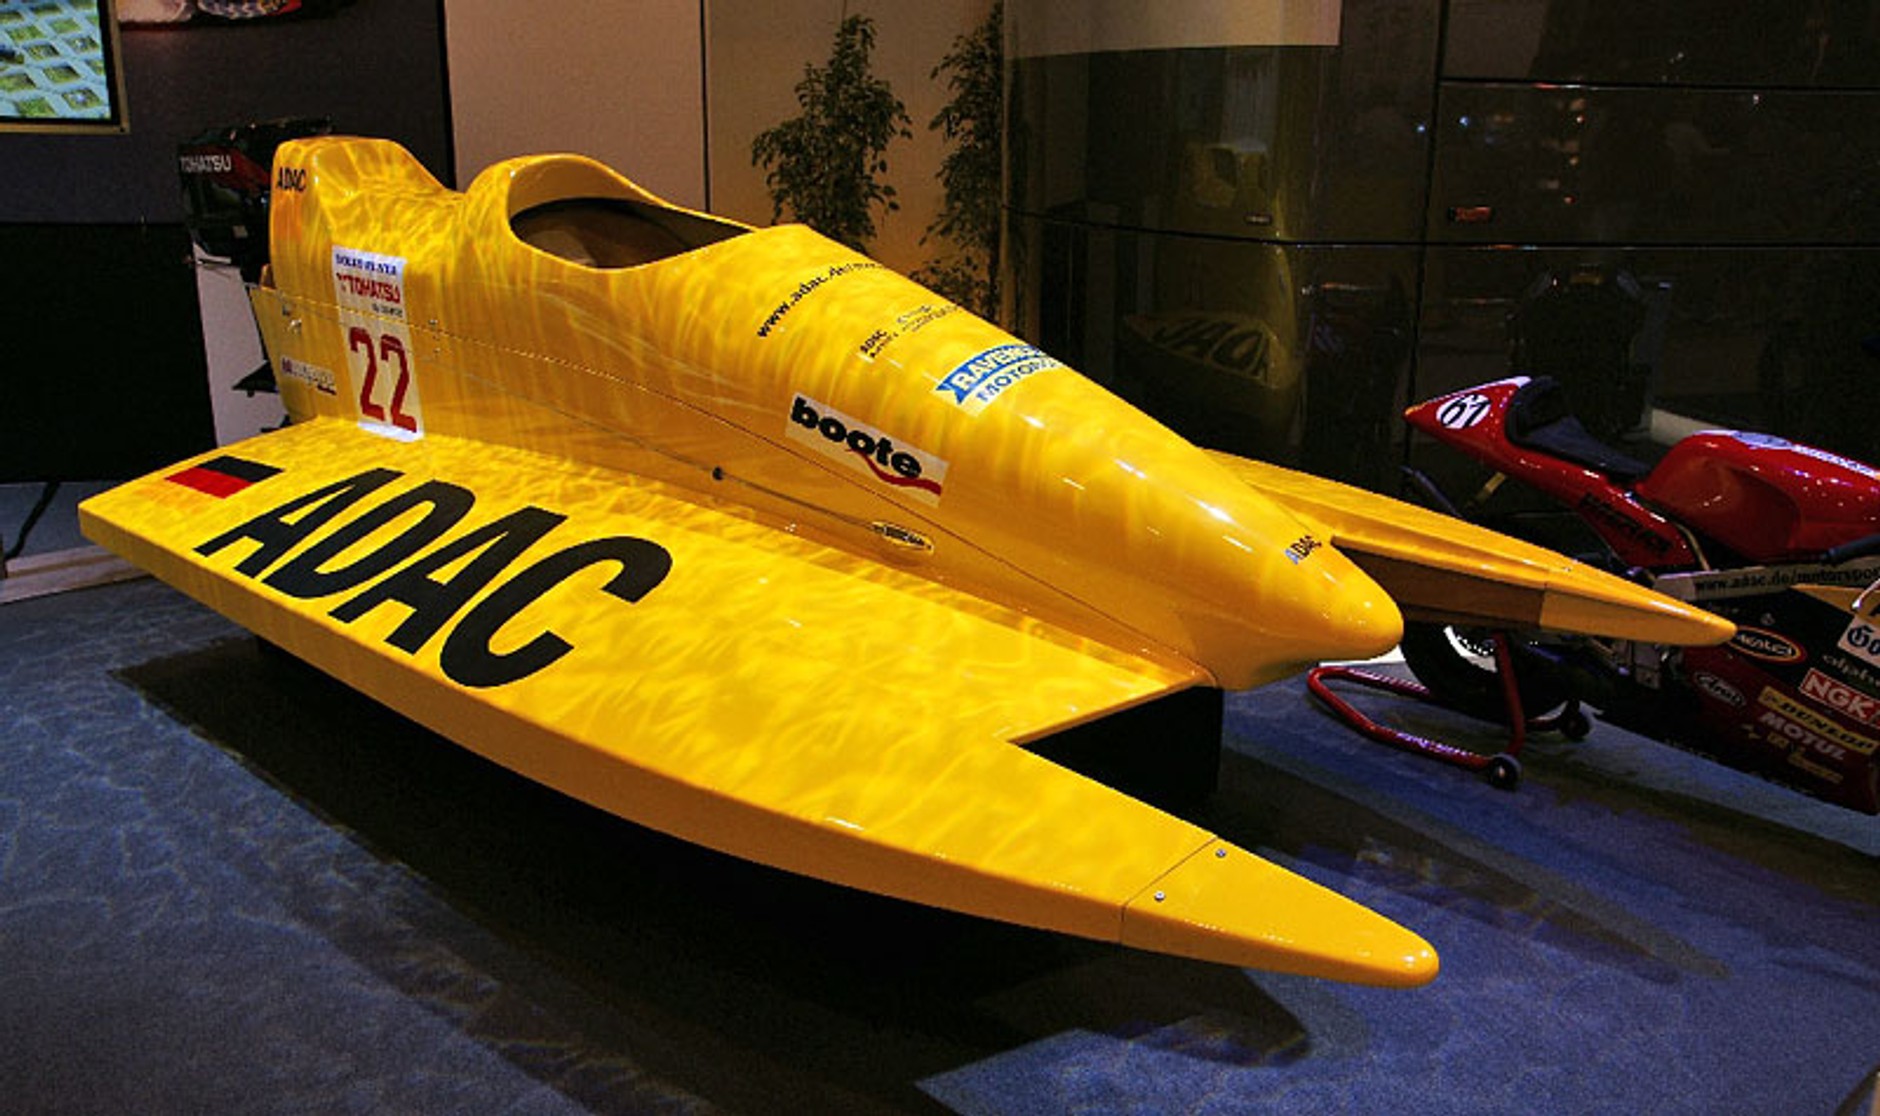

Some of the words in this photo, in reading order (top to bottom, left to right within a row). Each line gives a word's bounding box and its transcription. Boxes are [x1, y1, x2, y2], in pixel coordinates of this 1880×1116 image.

[276, 167, 307, 192] ADAC
[349, 326, 418, 433] 22
[790, 396, 923, 480] boote
[193, 467, 673, 689] ADAC
[1804, 673, 1875, 719] NGK
[1759, 711, 1847, 760] MOTUL
